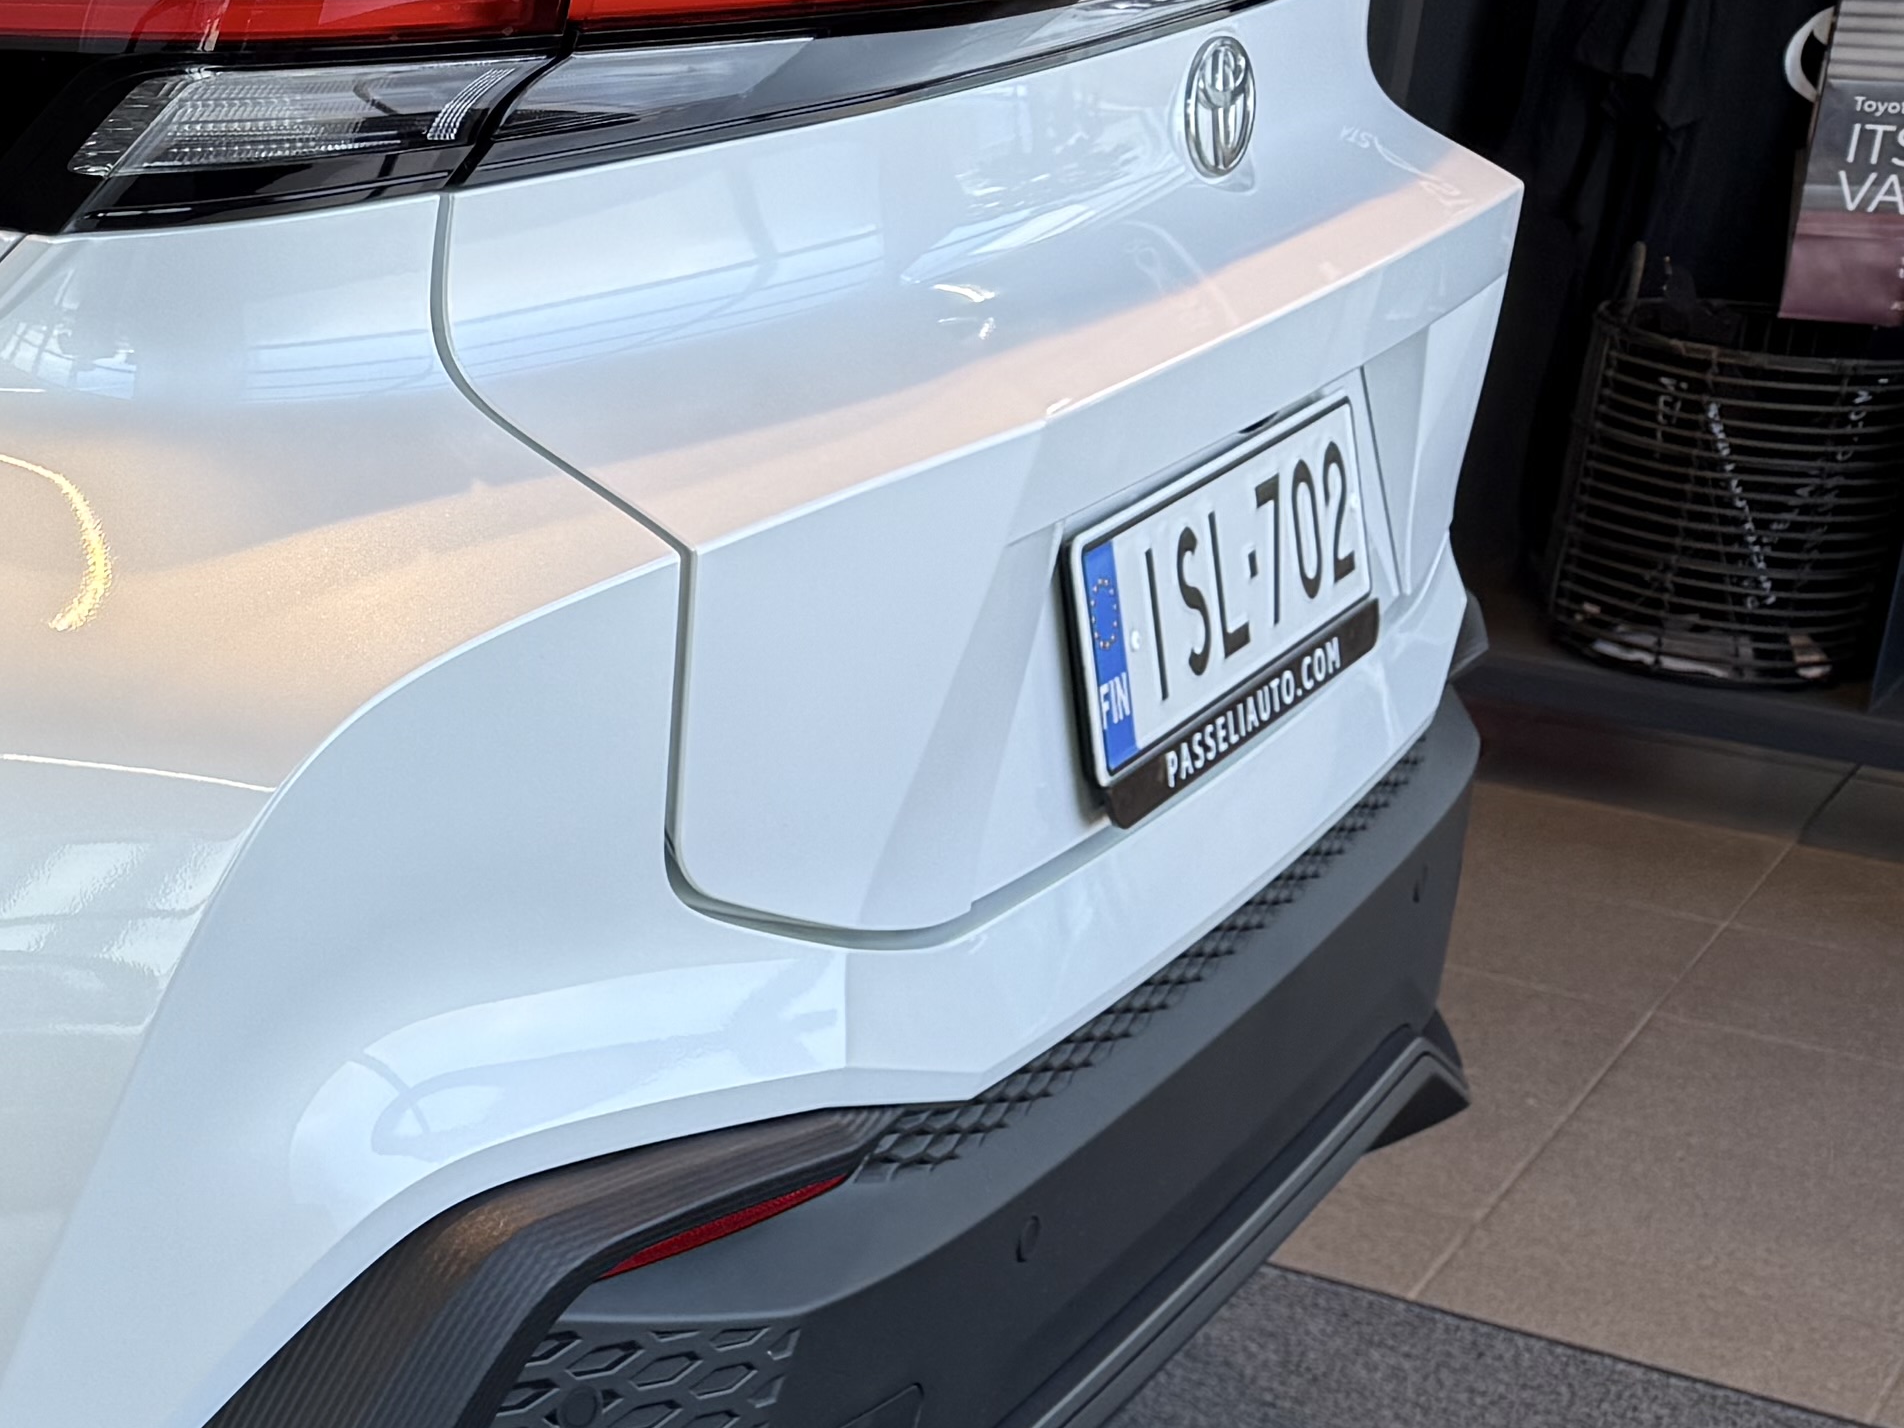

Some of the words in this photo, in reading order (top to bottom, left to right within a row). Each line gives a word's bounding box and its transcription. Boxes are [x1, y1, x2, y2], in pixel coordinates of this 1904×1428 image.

[1854, 96, 1904, 116] Toyo
[1145, 441, 1356, 702] ISL-702
[1099, 672, 1132, 730] FIN
[1165, 637, 1342, 788] PASSELIAUTO.COM
